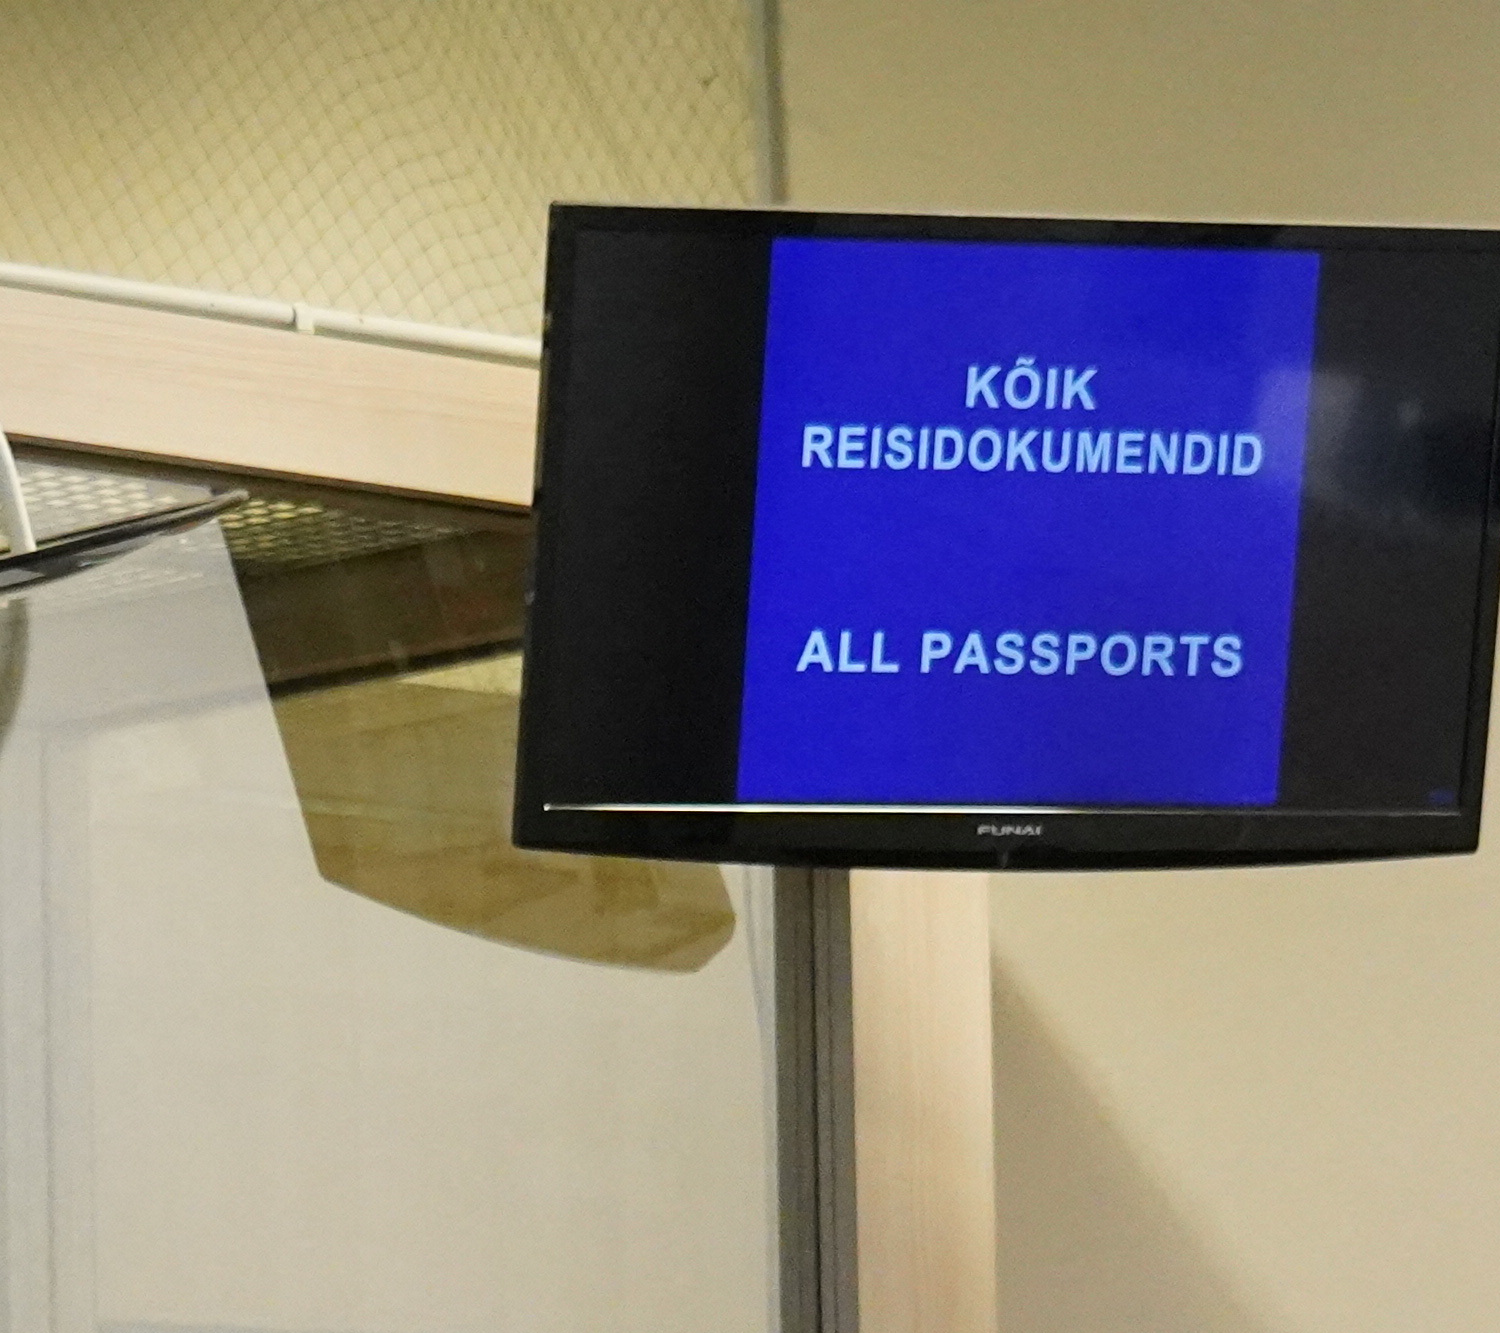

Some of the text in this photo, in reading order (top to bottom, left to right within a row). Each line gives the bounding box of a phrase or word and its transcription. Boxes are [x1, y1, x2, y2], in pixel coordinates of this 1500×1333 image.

[965, 356, 1098, 411] KÕIK
[801, 423, 1265, 477] REISIDOKUMENDID
[796, 628, 1245, 679] ALL PASSPORTS
[976, 823, 1043, 837] FUNAI
